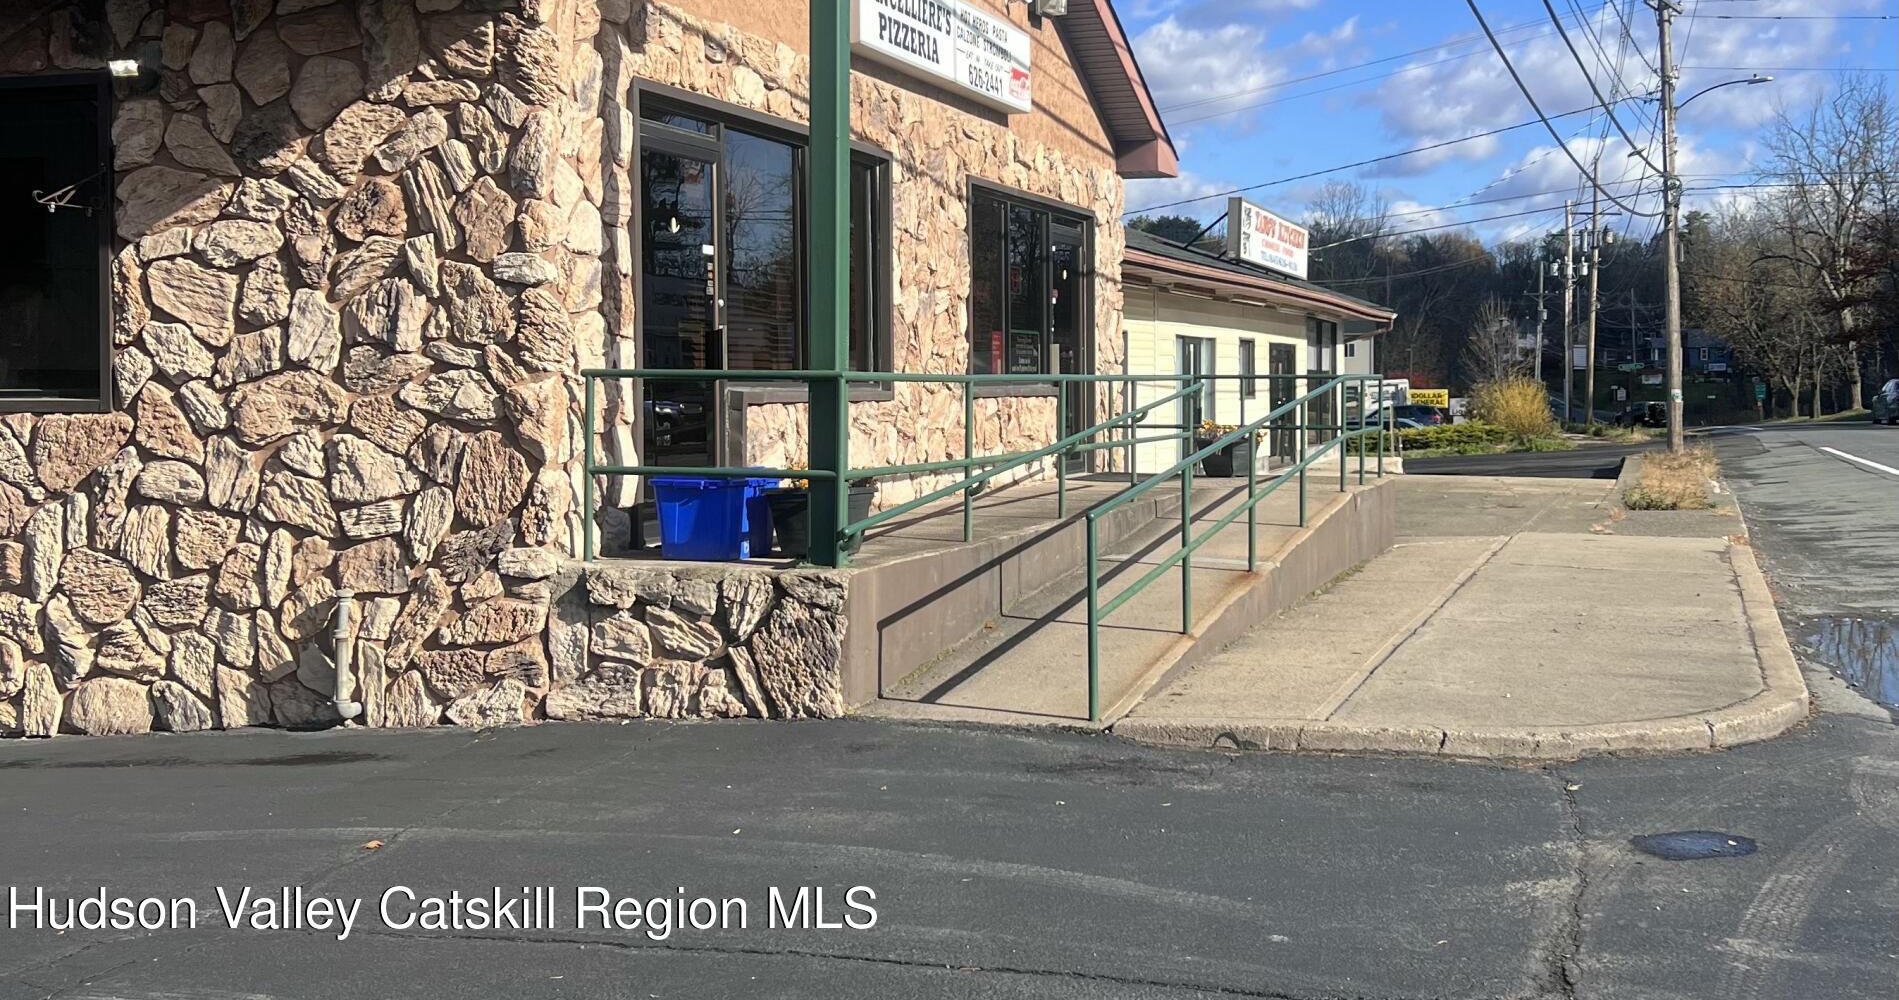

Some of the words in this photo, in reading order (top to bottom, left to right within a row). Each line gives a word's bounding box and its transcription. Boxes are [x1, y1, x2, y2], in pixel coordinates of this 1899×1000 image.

[878, 11, 940, 64] PIZZERIA
[956, 25, 980, 48] CALZONE
[968, 63, 1003, 97] 626-2441
